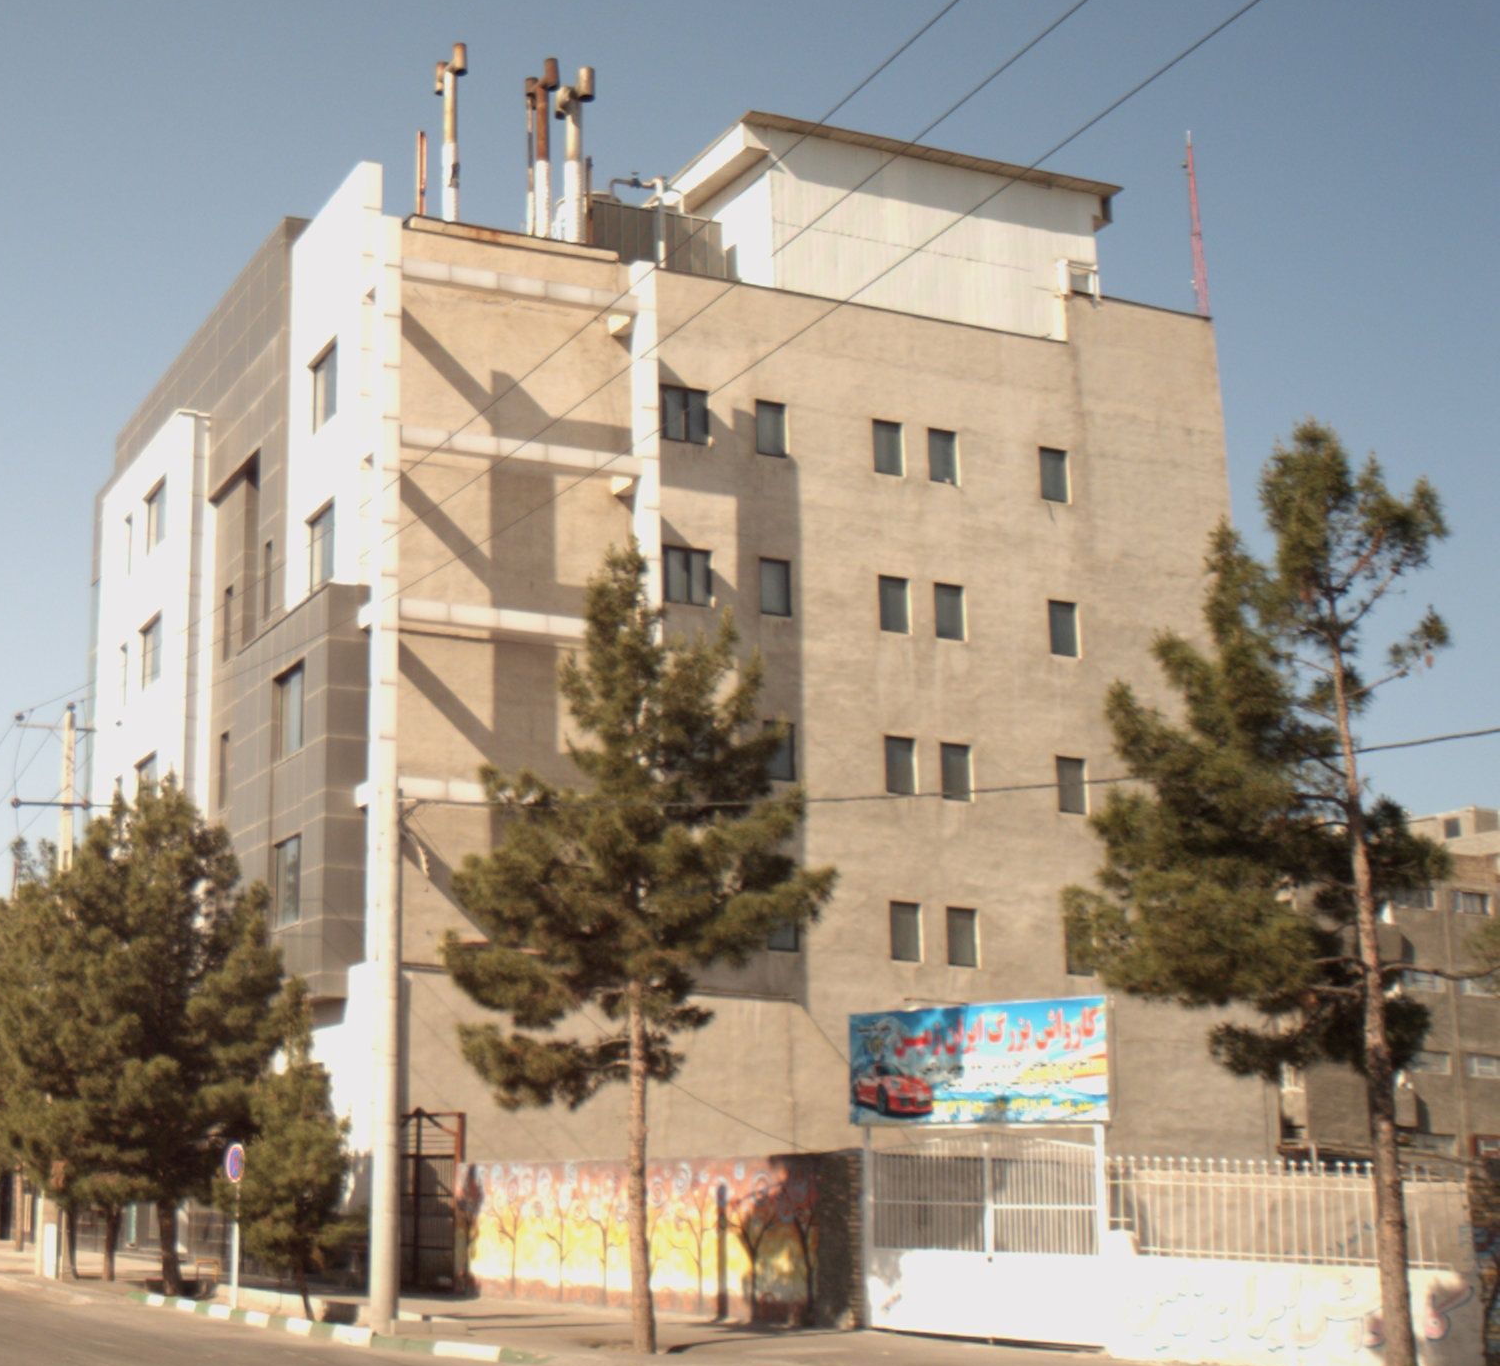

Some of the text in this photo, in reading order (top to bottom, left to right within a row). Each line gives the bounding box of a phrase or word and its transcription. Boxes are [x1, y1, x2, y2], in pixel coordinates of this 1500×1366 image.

[893, 1005, 1100, 1058] کارواش بزرگ ایران زمین
